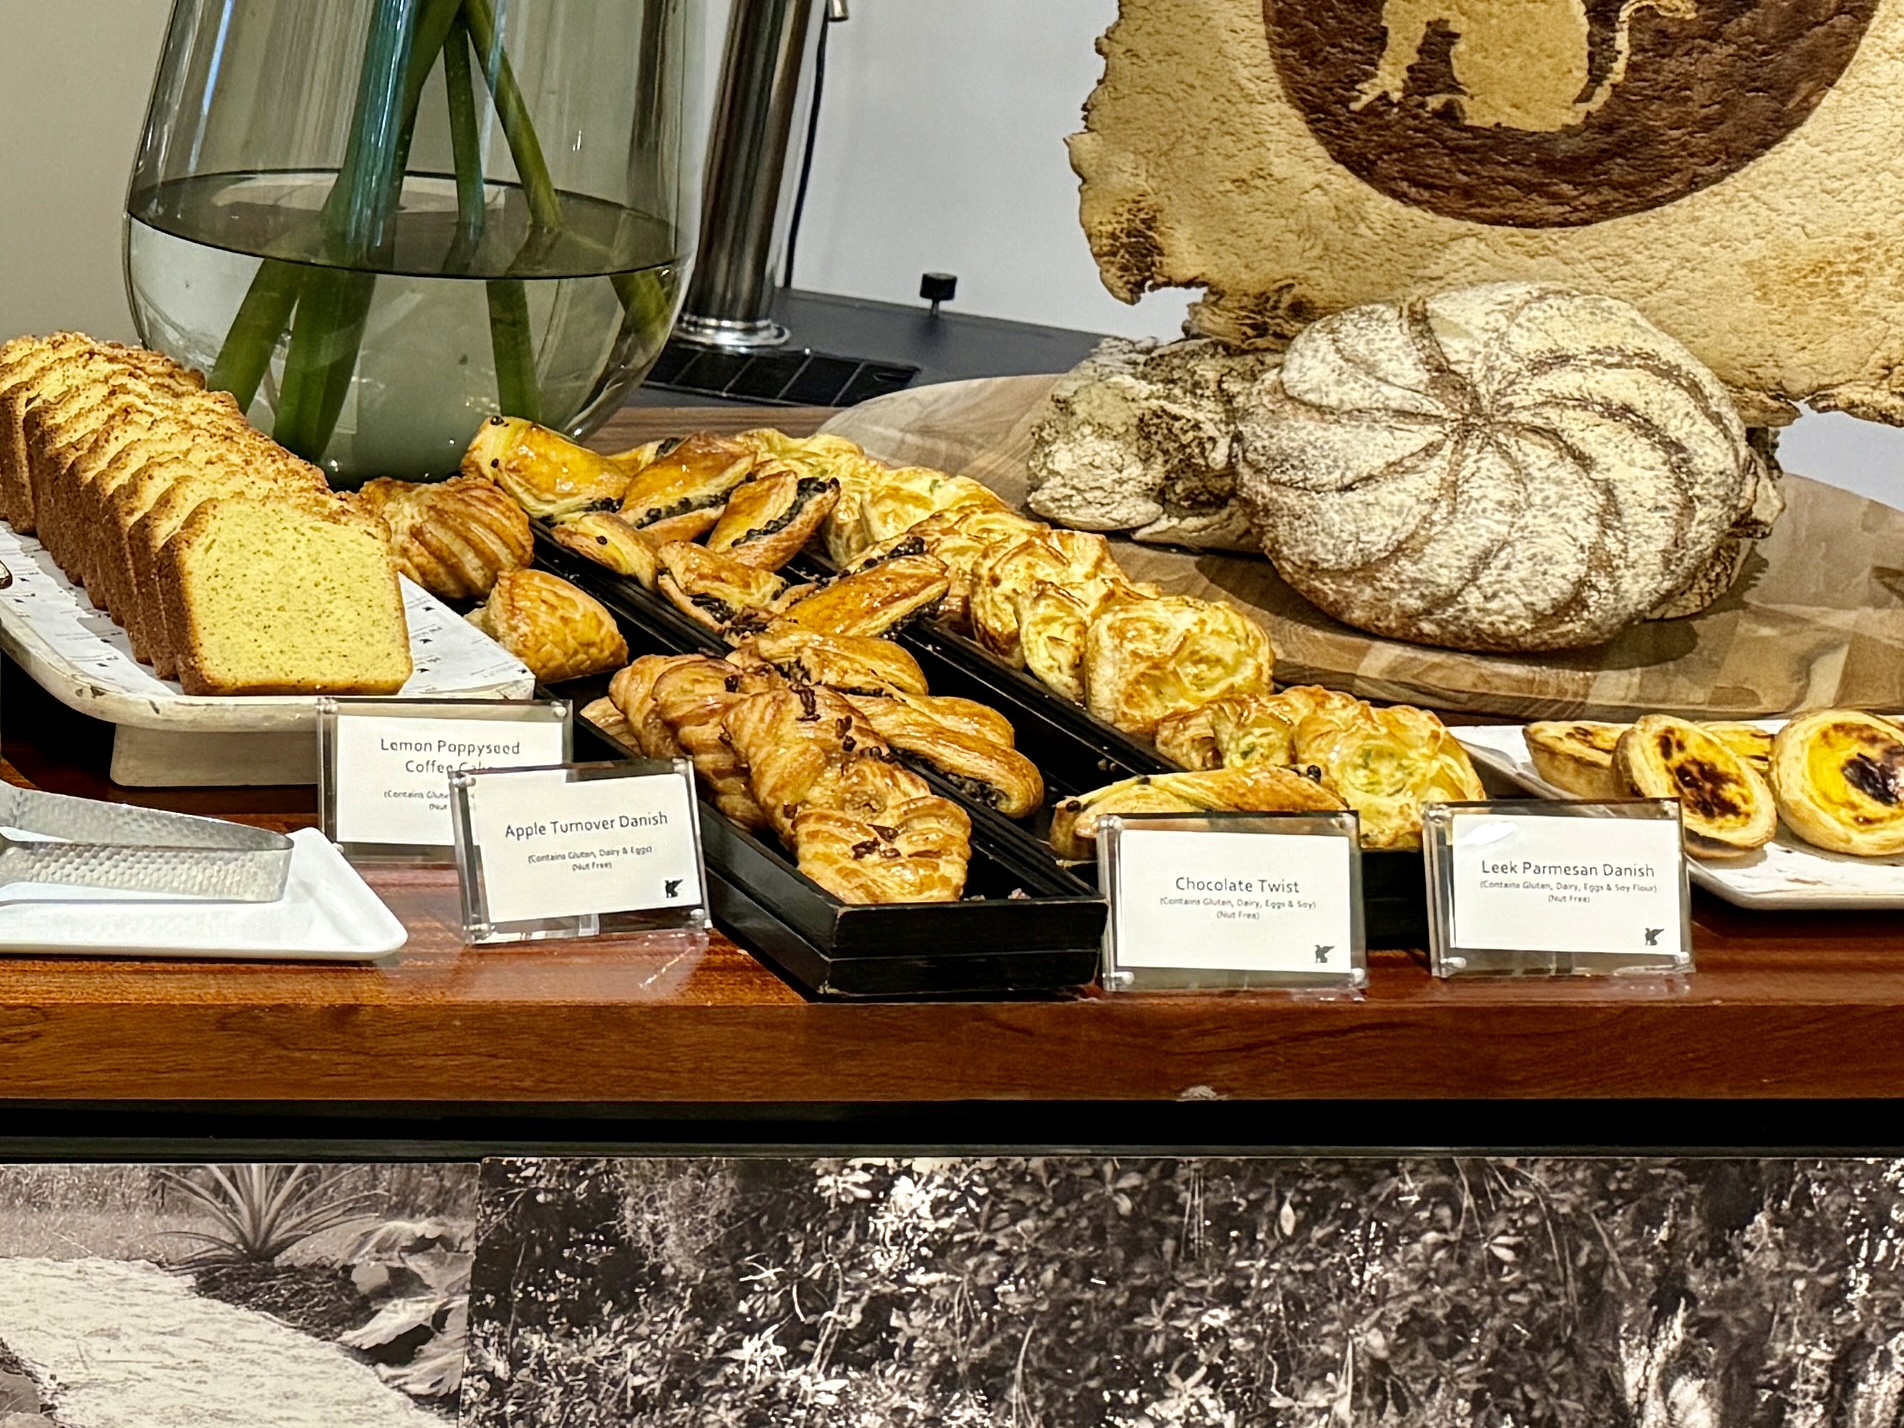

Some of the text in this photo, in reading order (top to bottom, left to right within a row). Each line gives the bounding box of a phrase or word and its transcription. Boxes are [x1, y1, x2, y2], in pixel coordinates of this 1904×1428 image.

[381, 738, 521, 757] Lemon Poppyseed
[405, 760, 453, 773] Coffee
[383, 790, 424, 799] (Contains
[504, 811, 668, 841] Apple Turnover Danish
[527, 853, 566, 864] (Contains
[568, 850, 597, 860] Gluten,
[599, 848, 620, 858] Dairy
[622, 847, 628, 855] &
[1481, 860, 1655, 877] Leek Parmesan Danish
[1175, 876, 1300, 893] Chocolate Twist
[1480, 880, 1520, 890] (Contains
[1522, 881, 1553, 891] Gluten,
[1556, 882, 1581, 892] Dairy,
[1584, 882, 1604, 893] Eggs
[1606, 883, 1612, 891] &
[1615, 883, 1630, 893] Soy
[1160, 896, 1317, 910] (Contains Gluten, Dairy, Eggs & Soy)
[1548, 894, 1591, 903] (Nut Free)
[1216, 910, 1260, 920] (Nut Free)
